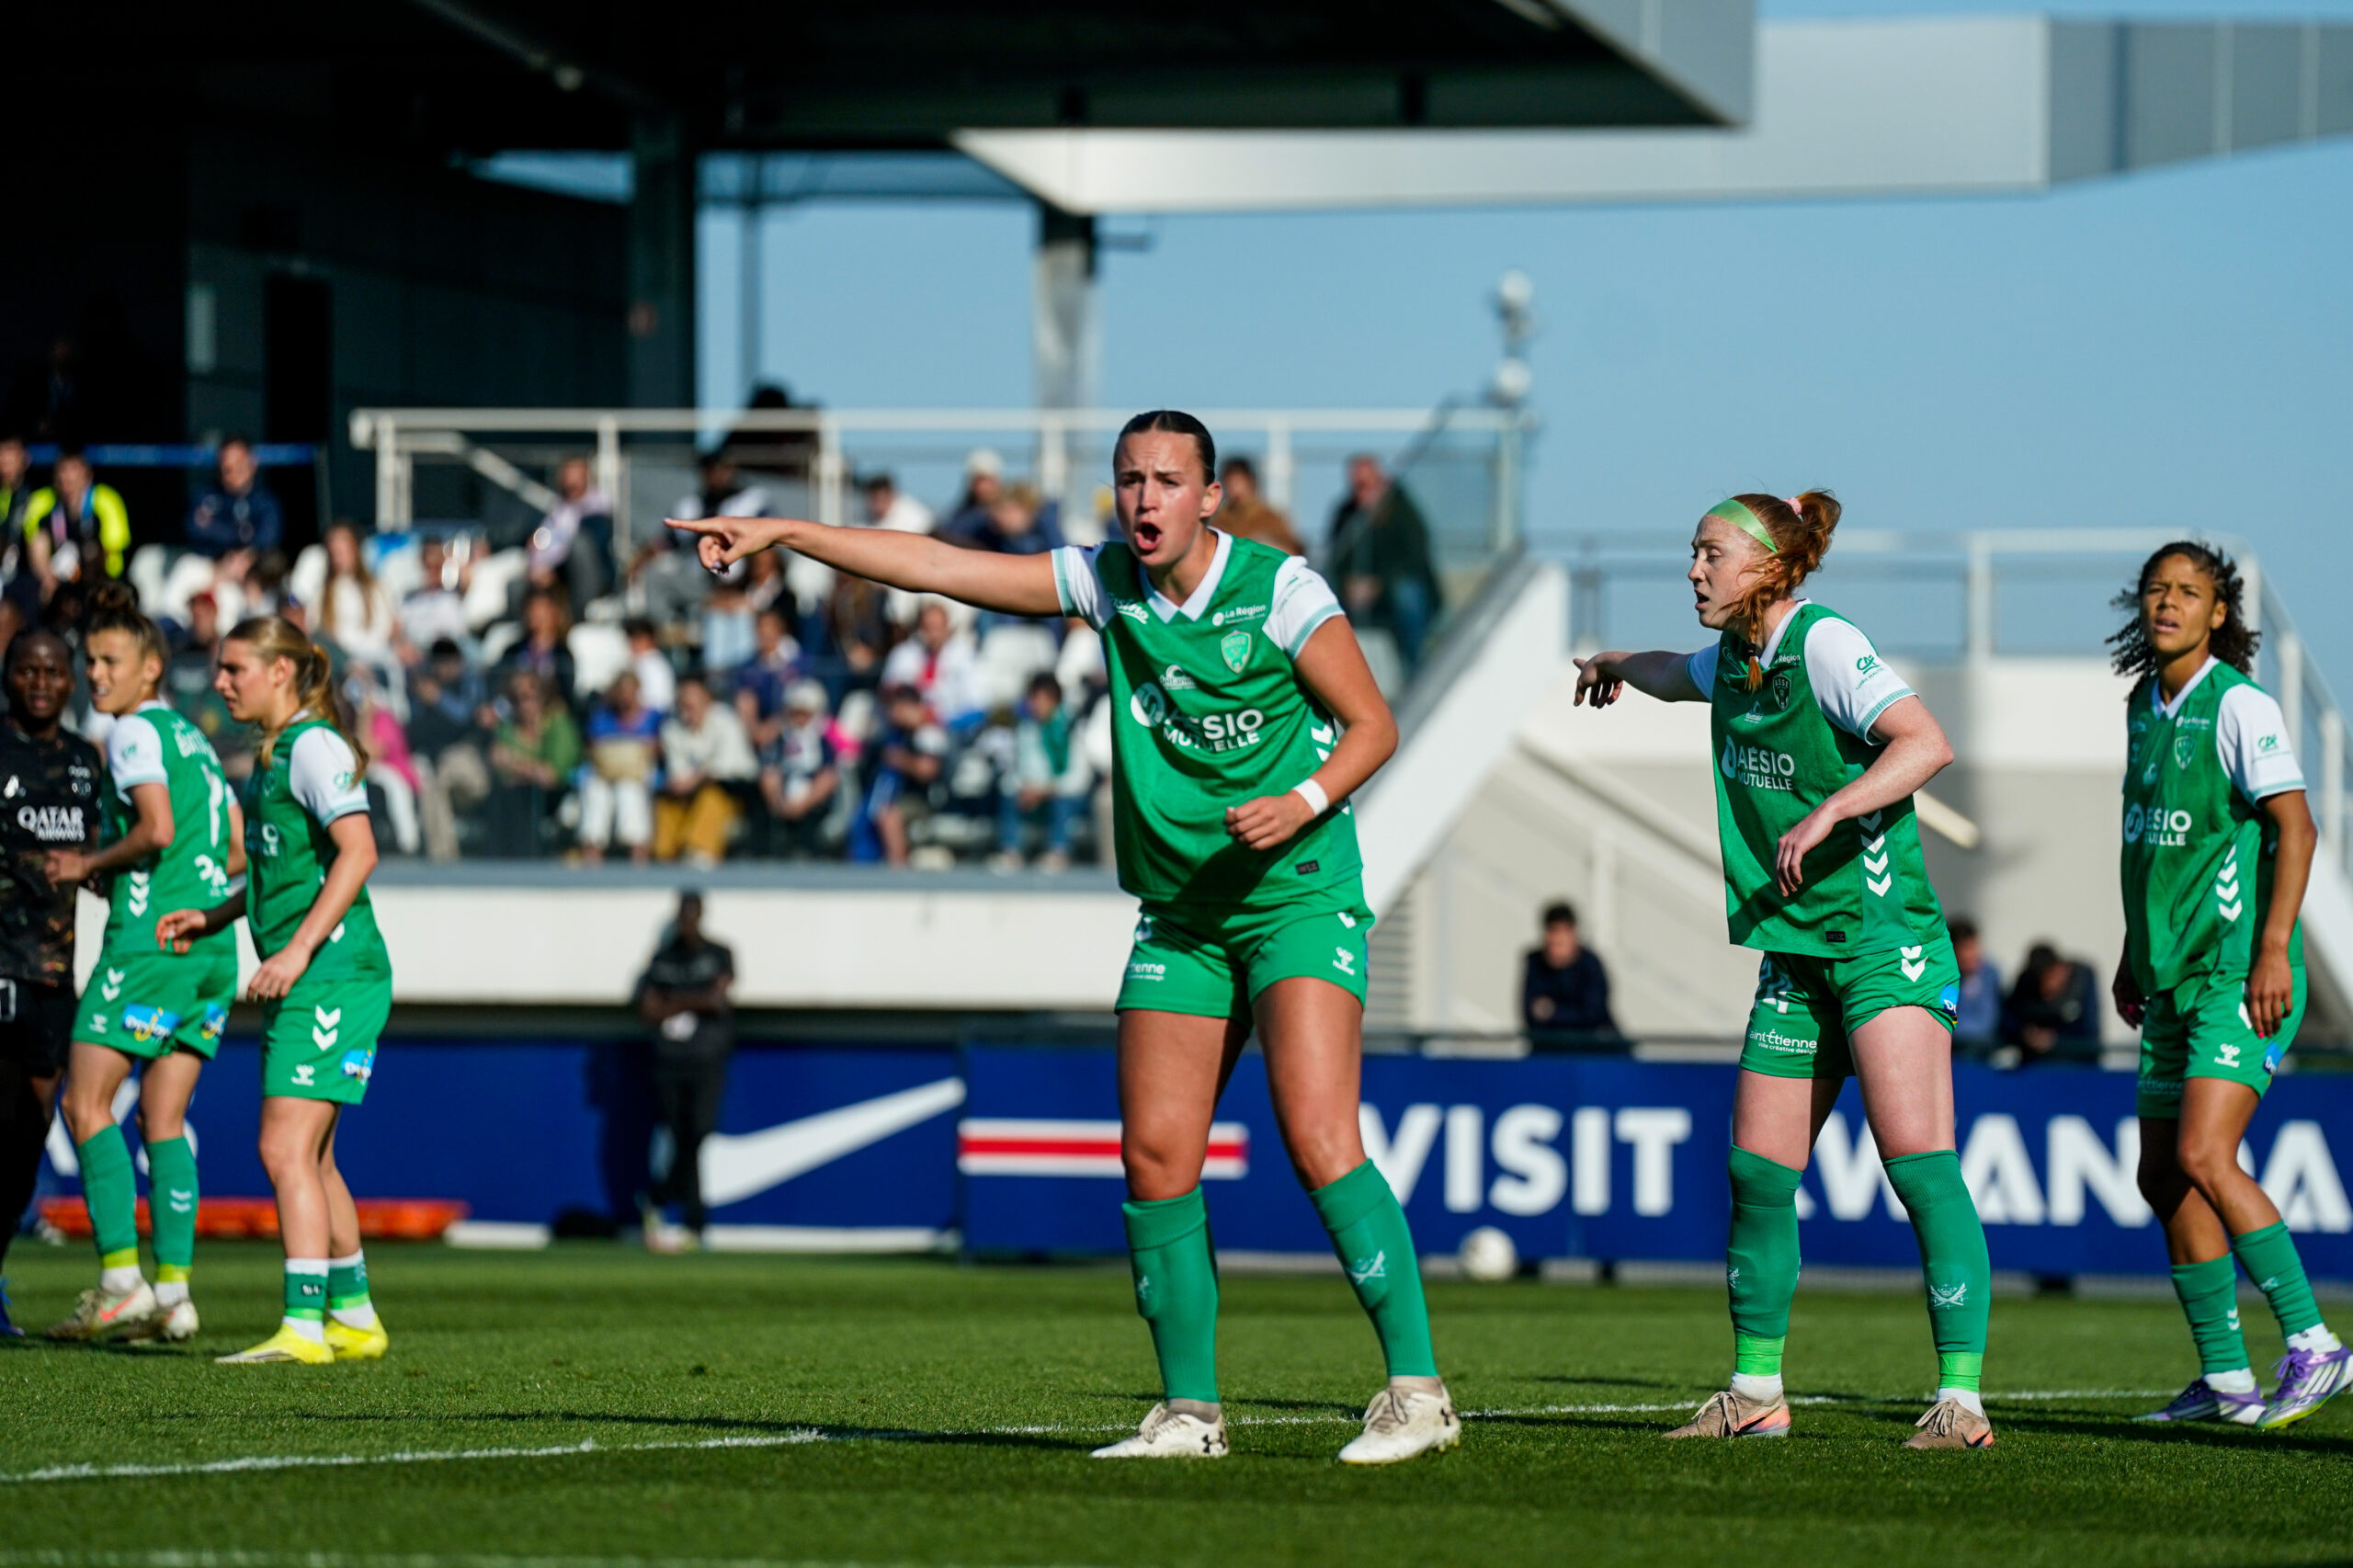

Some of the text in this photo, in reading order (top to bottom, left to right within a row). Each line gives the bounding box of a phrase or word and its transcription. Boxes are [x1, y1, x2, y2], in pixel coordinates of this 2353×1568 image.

[1737, 745, 1795, 777] AÉSIO
[1738, 770, 1793, 790] MUTUELLE
[17, 805, 85, 833] QATAR
[1358, 1102, 2353, 1234] VISIT WANA
